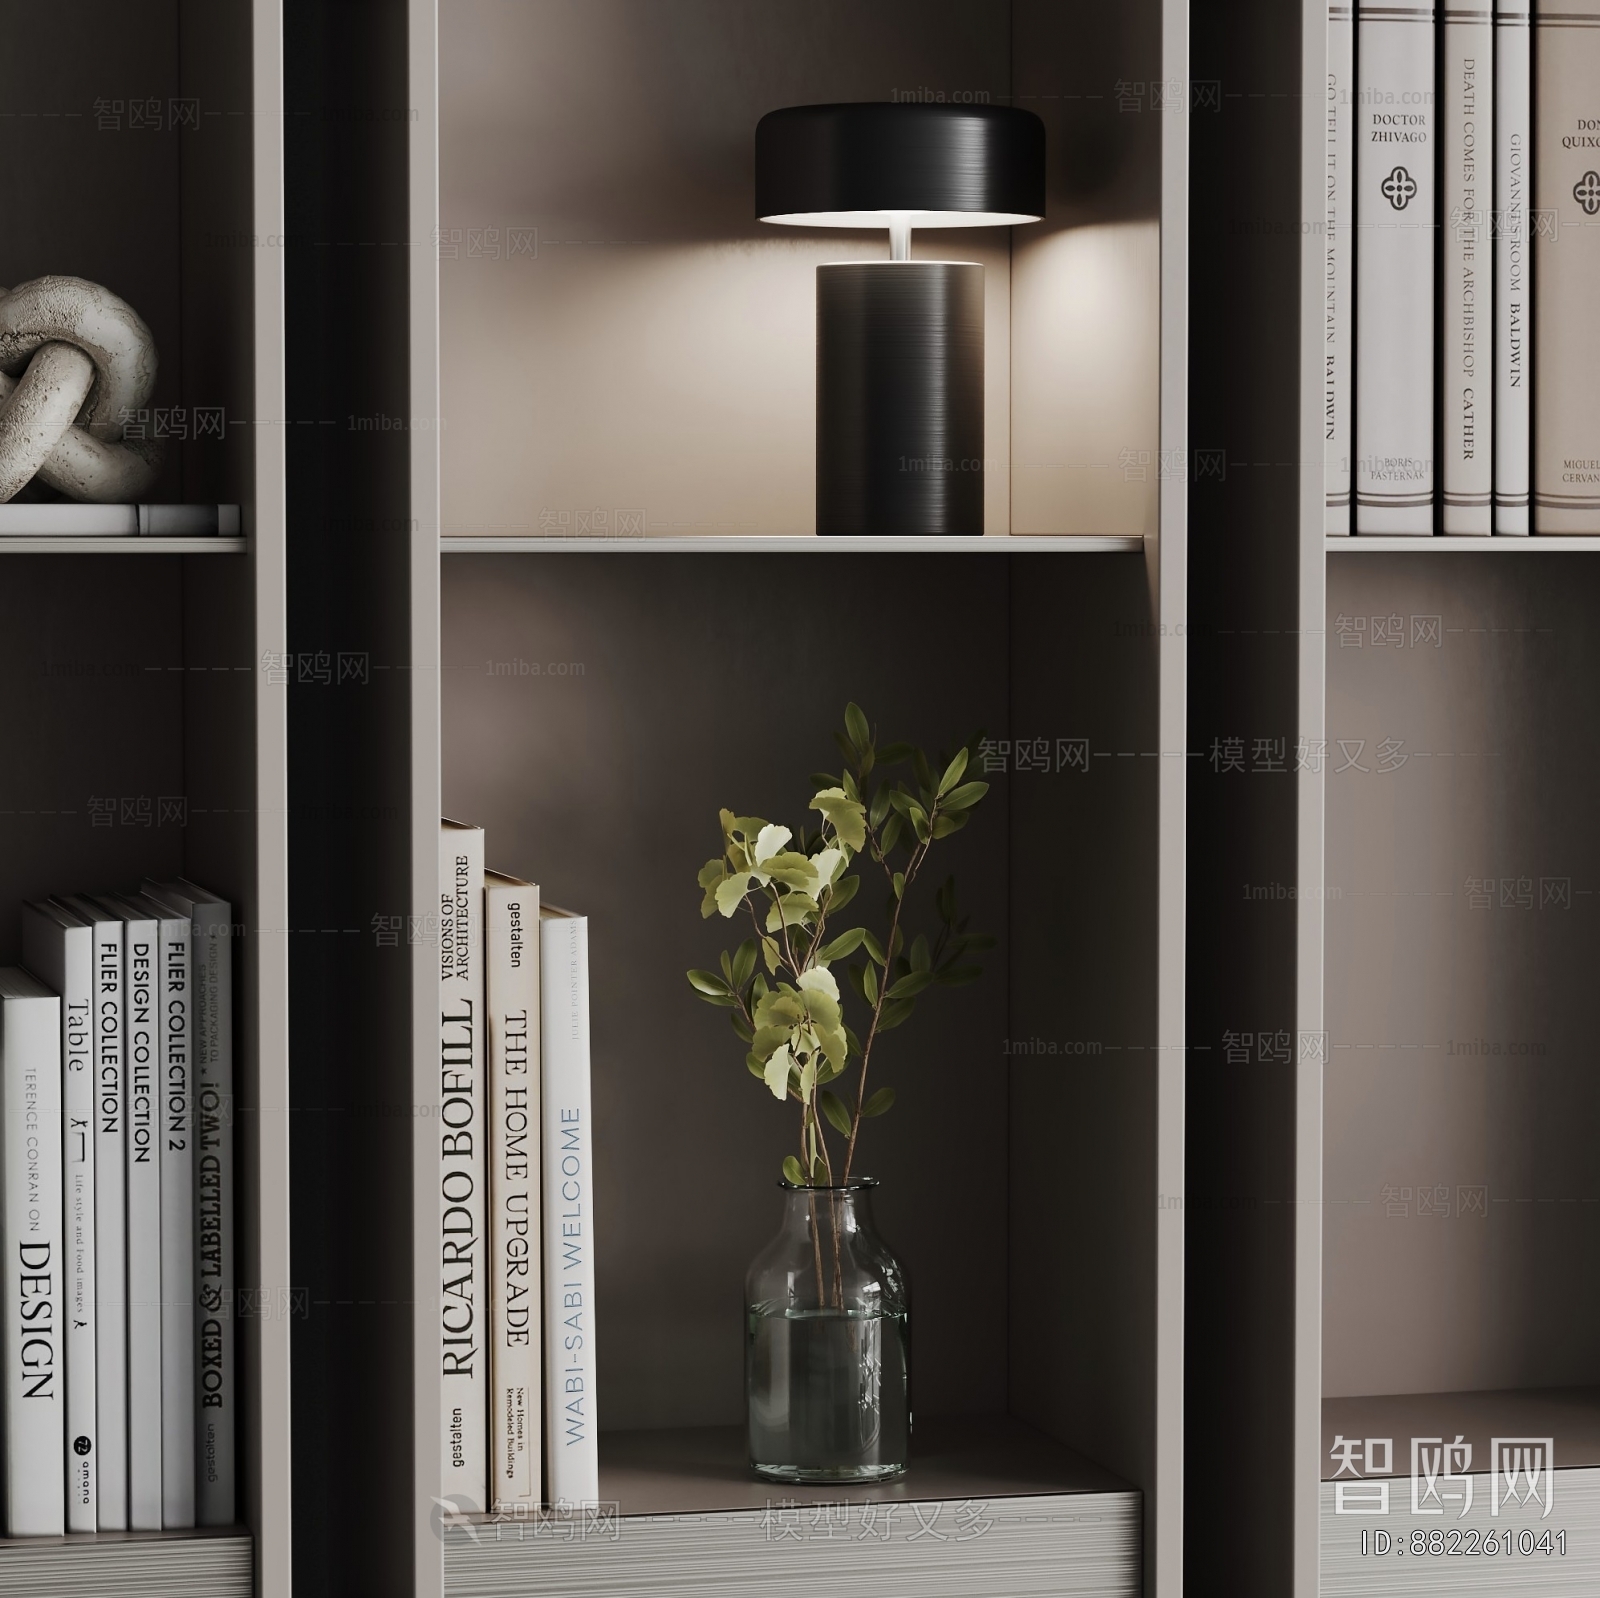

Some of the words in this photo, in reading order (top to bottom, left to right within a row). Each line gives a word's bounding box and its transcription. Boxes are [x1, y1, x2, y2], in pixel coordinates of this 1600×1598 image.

[1463, 58, 1475, 115] DEATH
[1371, 131, 1427, 143] ZHIVAGO
[1372, 114, 1426, 126] DOCTOR
[1463, 121, 1475, 182] COMES
[1463, 188, 1475, 222] FOR
[1463, 228, 1475, 261] THE
[1510, 240, 1521, 291] ROOM
[1463, 267, 1475, 377] ARCHBISHOP
[1509, 303, 1521, 388] BALDWIN
[1462, 388, 1475, 461] CATHER
[1370, 470, 1426, 481] PASTERNAK
[1384, 457, 1413, 468] BORIS
[1563, 459, 1600, 470] MIGUEL
[441, 893, 453, 922] OF
[455, 855, 470, 981] ARCHITECTURE
[507, 902, 523, 968] gestalten
[100, 943, 118, 993] FLIER
[133, 943, 150, 1022] DESIGN
[168, 942, 185, 993] FLIER
[209, 943, 219, 983] DESIGN
[441, 923, 453, 981] VISIONS
[68, 999, 89, 1072] Table
[168, 1000, 186, 1132] COLLECTION
[505, 1009, 528, 1075] THE
[101, 1001, 119, 1133] COLLECTION
[134, 1031, 151, 1163] COLLECTION
[441, 998, 474, 1160] BOFILL
[24, 1068, 38, 1131] TERENCE
[200, 1082, 221, 1151] TWO!
[169, 1139, 186, 1152] 2
[505, 1086, 528, 1181] HOME
[26, 1136, 39, 1203] CONRAN
[560, 1107, 583, 1270] WELCOME
[28, 1209, 40, 1232] ON
[200, 1154, 222, 1278] LABELLED
[200, 1284, 222, 1313] &
[441, 1170, 478, 1379] RICARDO
[505, 1192, 530, 1348] UPGRADE
[19, 1239, 55, 1401] DESIGN
[202, 1318, 223, 1410] BOXED
[562, 1281, 586, 1446] WABI-SABI
[506, 1388, 515, 1435] Remodeled
[516, 1387, 524, 1406] New
[516, 1408, 525, 1439] Homes
[207, 1422, 217, 1483] gestalten
[450, 1408, 465, 1467] gestalten
[506, 1438, 515, 1479] Buildings
[517, 1441, 525, 1452] in
[82, 1461, 90, 1504] amana
